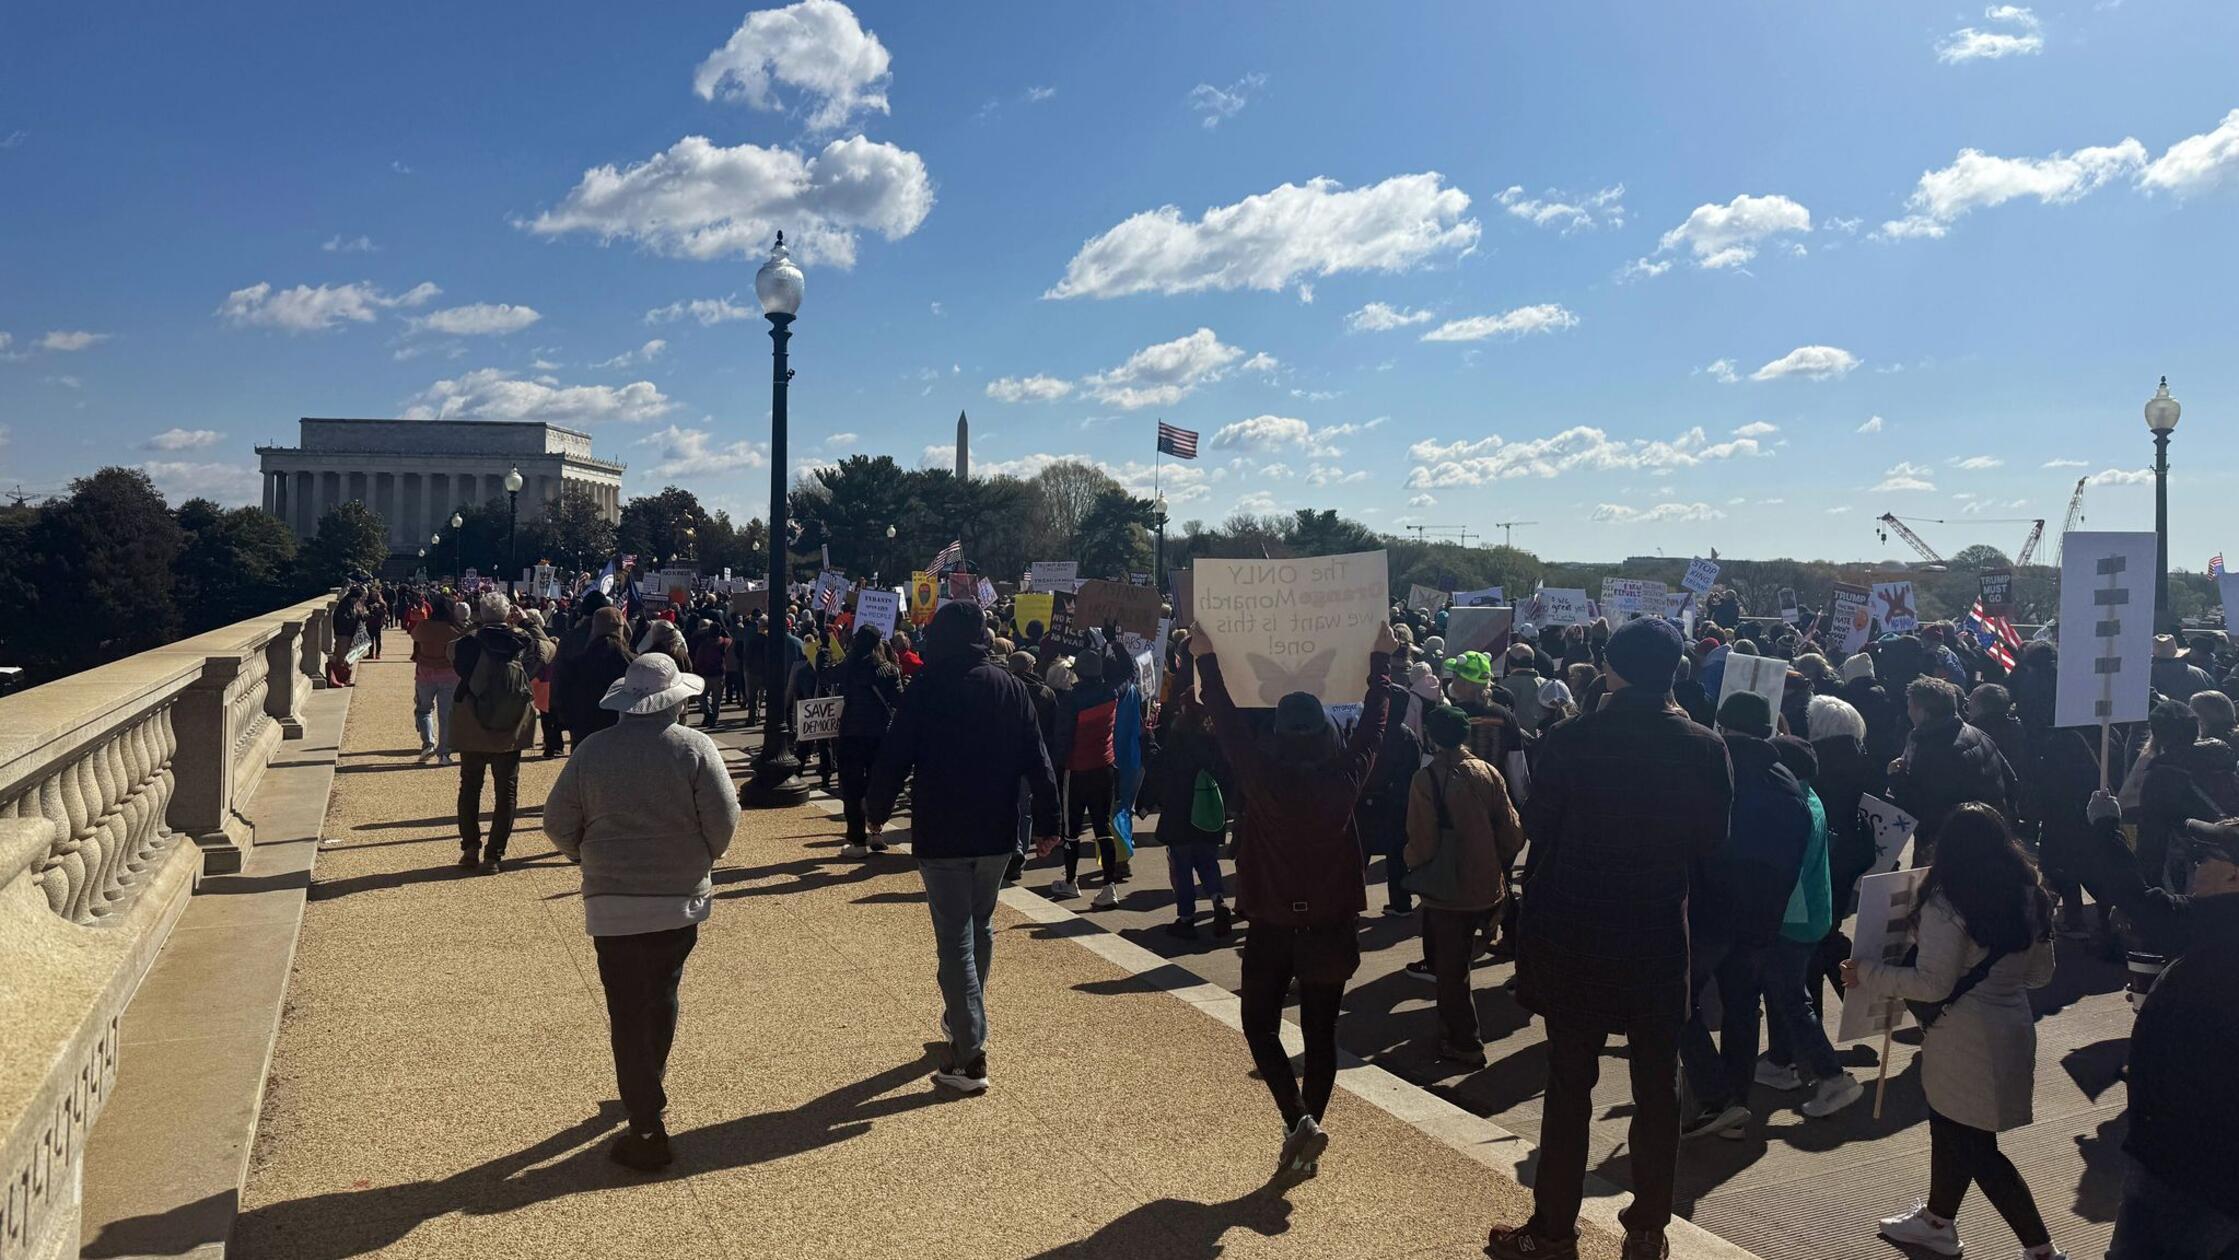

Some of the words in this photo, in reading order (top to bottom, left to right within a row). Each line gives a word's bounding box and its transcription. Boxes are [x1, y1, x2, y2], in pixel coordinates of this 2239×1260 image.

[1692, 560, 1717, 574] STOP
[1690, 570, 1711, 584] KING
[1981, 575, 2009, 584] TRUMP
[1685, 577, 1707, 591] TRUMP
[1983, 584, 2008, 594] MUST
[1834, 590, 1867, 602] TRUMP
[1989, 594, 2001, 602] GO
[1052, 613, 1064, 622] NO
[1065, 626, 1084, 637] ICE
[1063, 635, 1084, 647] WAR
[804, 702, 836, 718] SAVE
